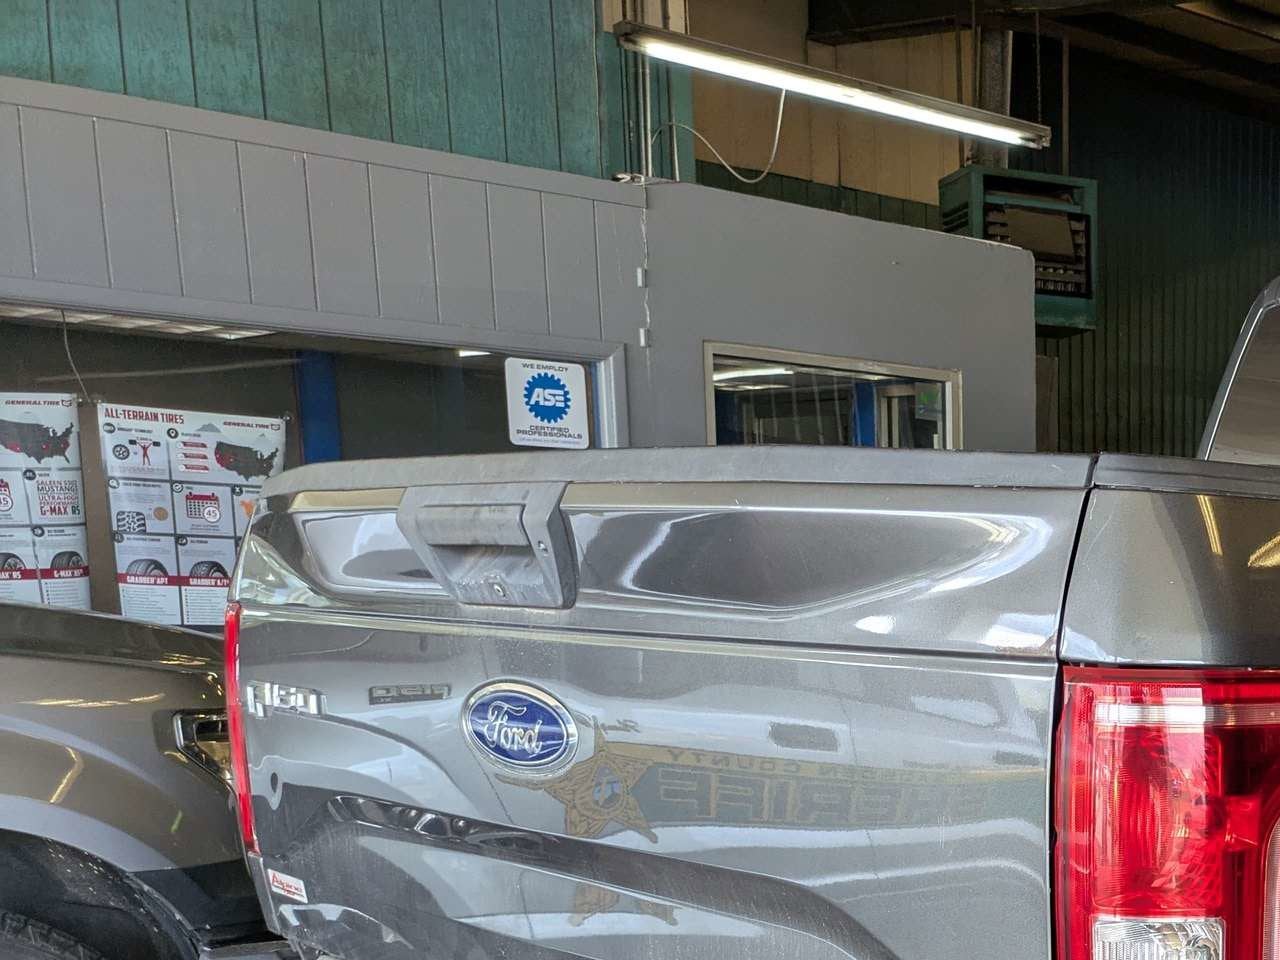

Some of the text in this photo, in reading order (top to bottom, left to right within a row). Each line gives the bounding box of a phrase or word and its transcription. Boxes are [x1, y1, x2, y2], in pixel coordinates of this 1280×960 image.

[536, 364, 568, 373] EMPLOY
[529, 388, 566, 408] ASE
[105, 408, 185, 424] ALL-TERRAIN TIRES
[529, 424, 570, 433] CERTIFIED
[516, 429, 583, 440] PROFESSIONALS
[40, 505, 68, 516] G-MAX
[206, 509, 218, 519] 45
[483, 700, 544, 755] Ford
